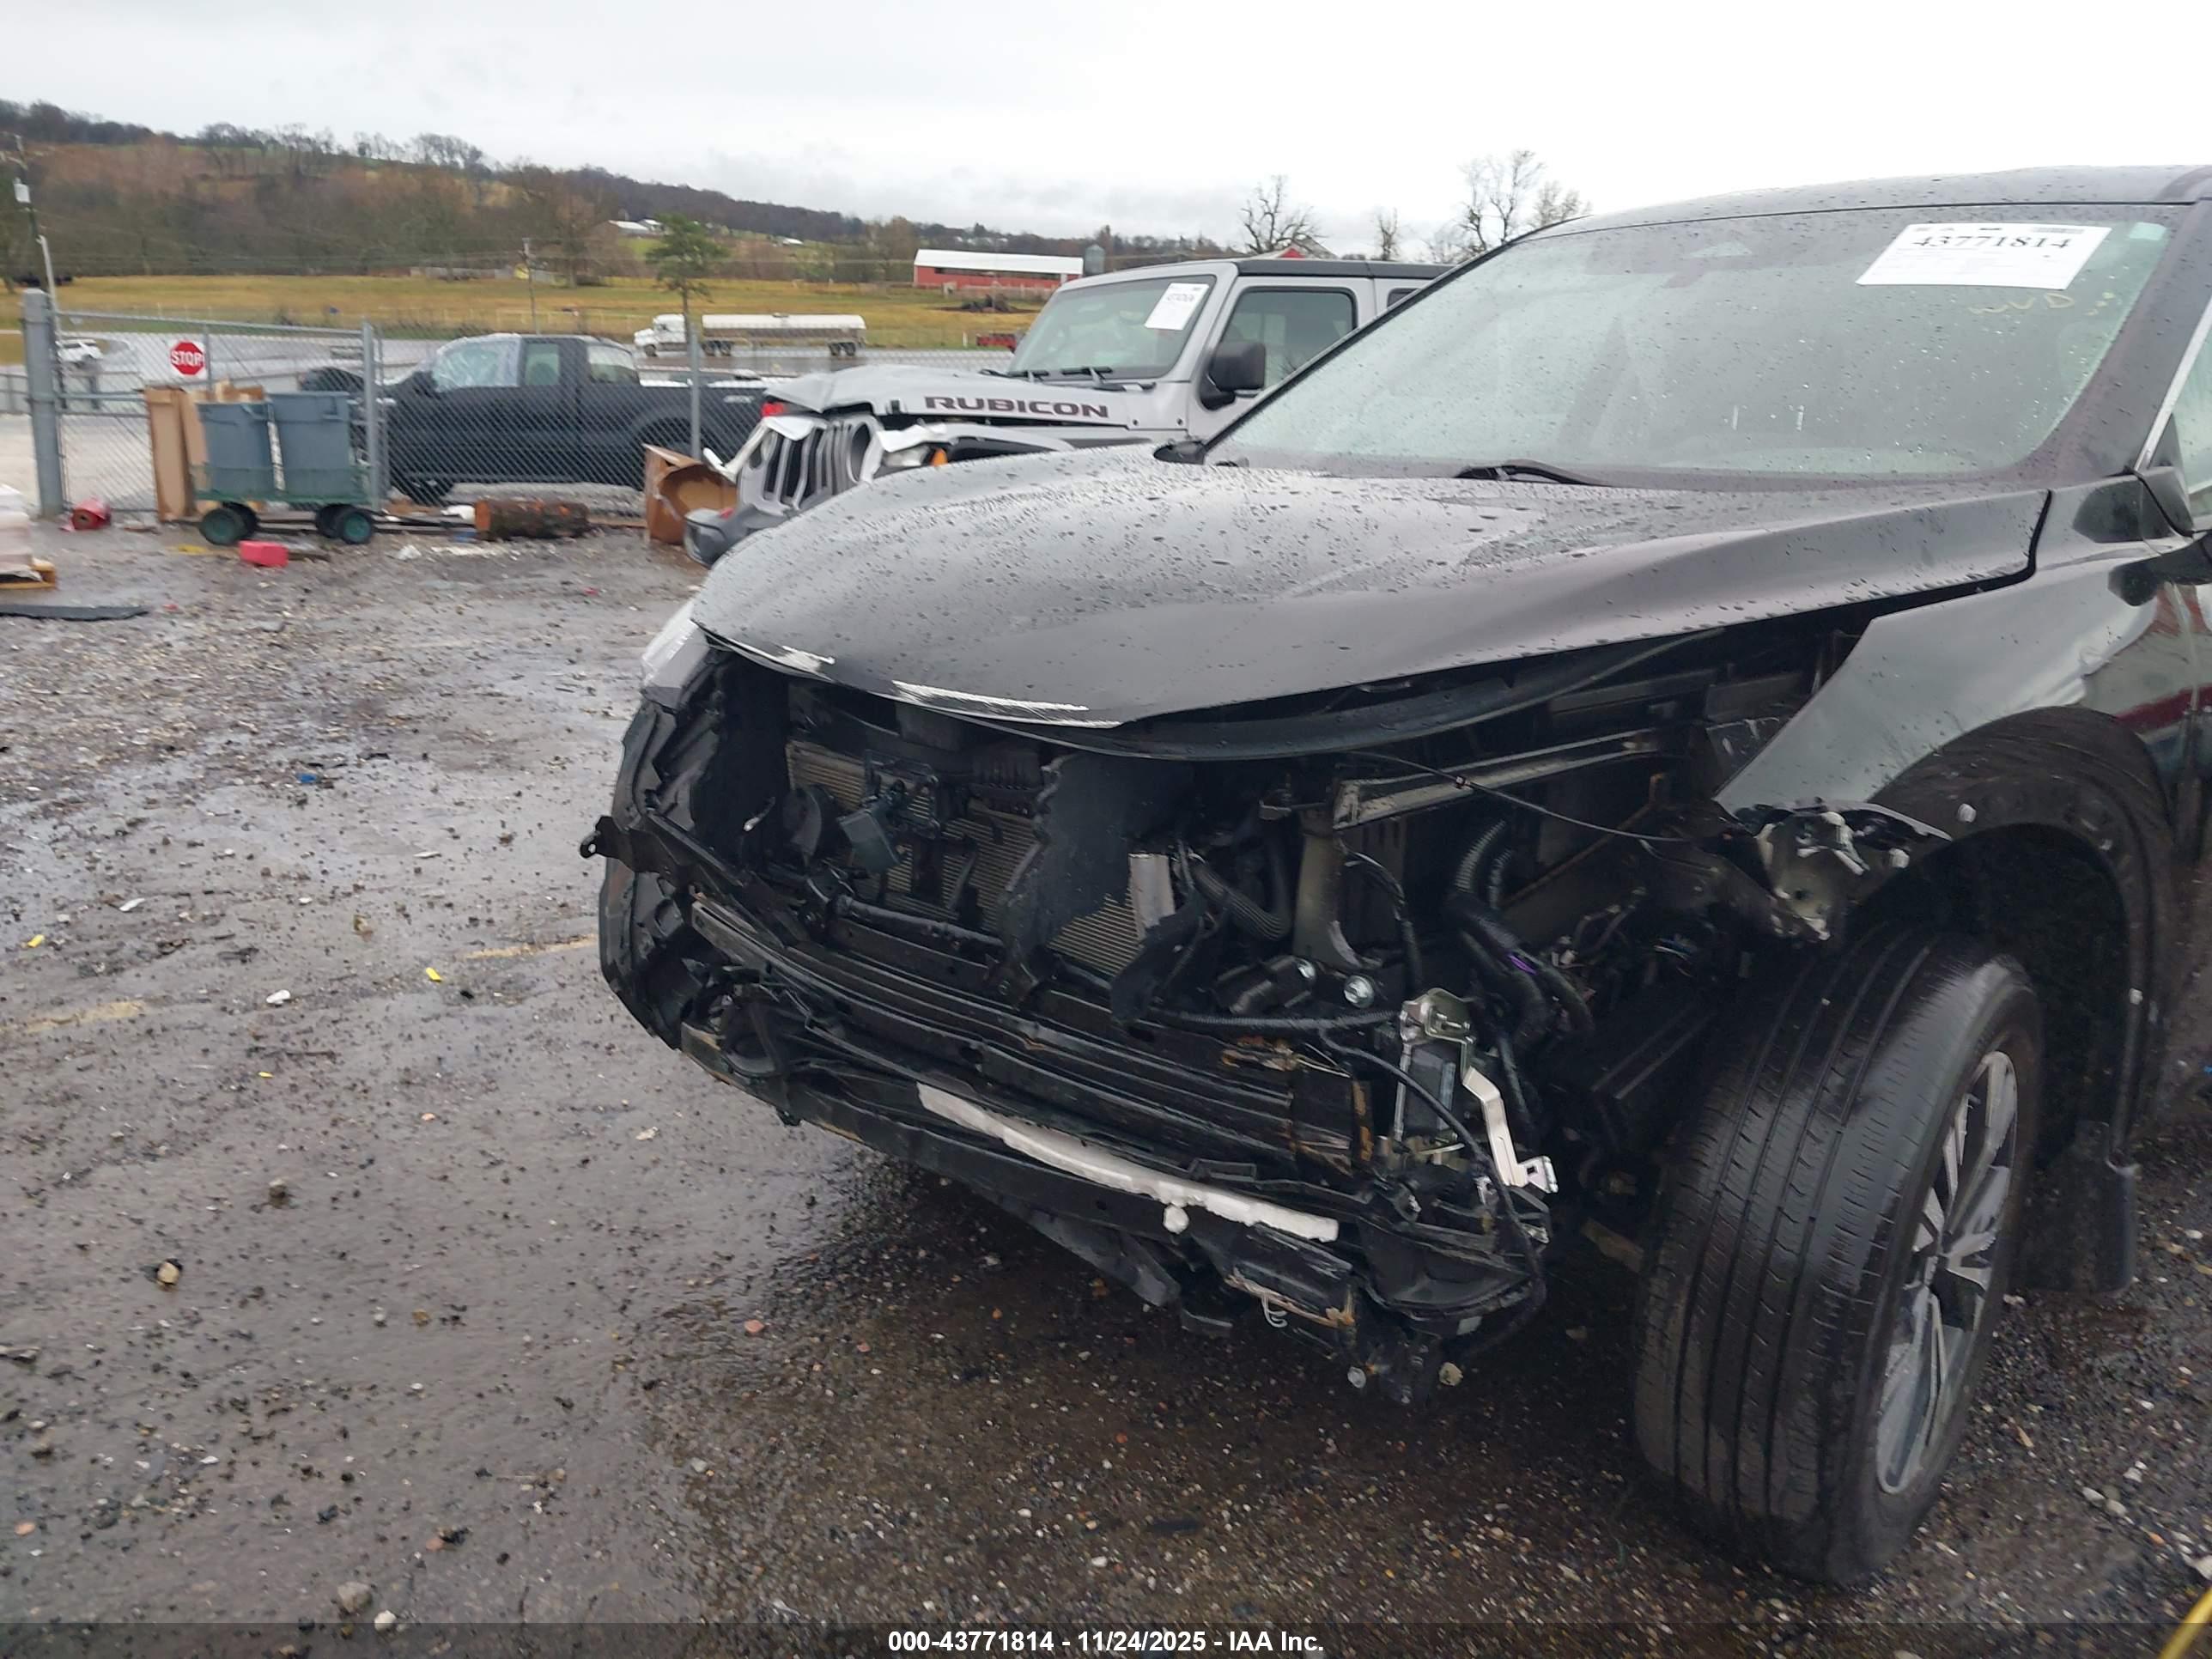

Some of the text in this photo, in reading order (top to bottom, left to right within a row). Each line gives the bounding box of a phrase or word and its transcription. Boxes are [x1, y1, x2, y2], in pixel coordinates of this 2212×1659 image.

[1913, 235, 2071, 249] 43771814
[171, 349, 204, 366] STOP
[924, 396, 1109, 418] RUBICON
